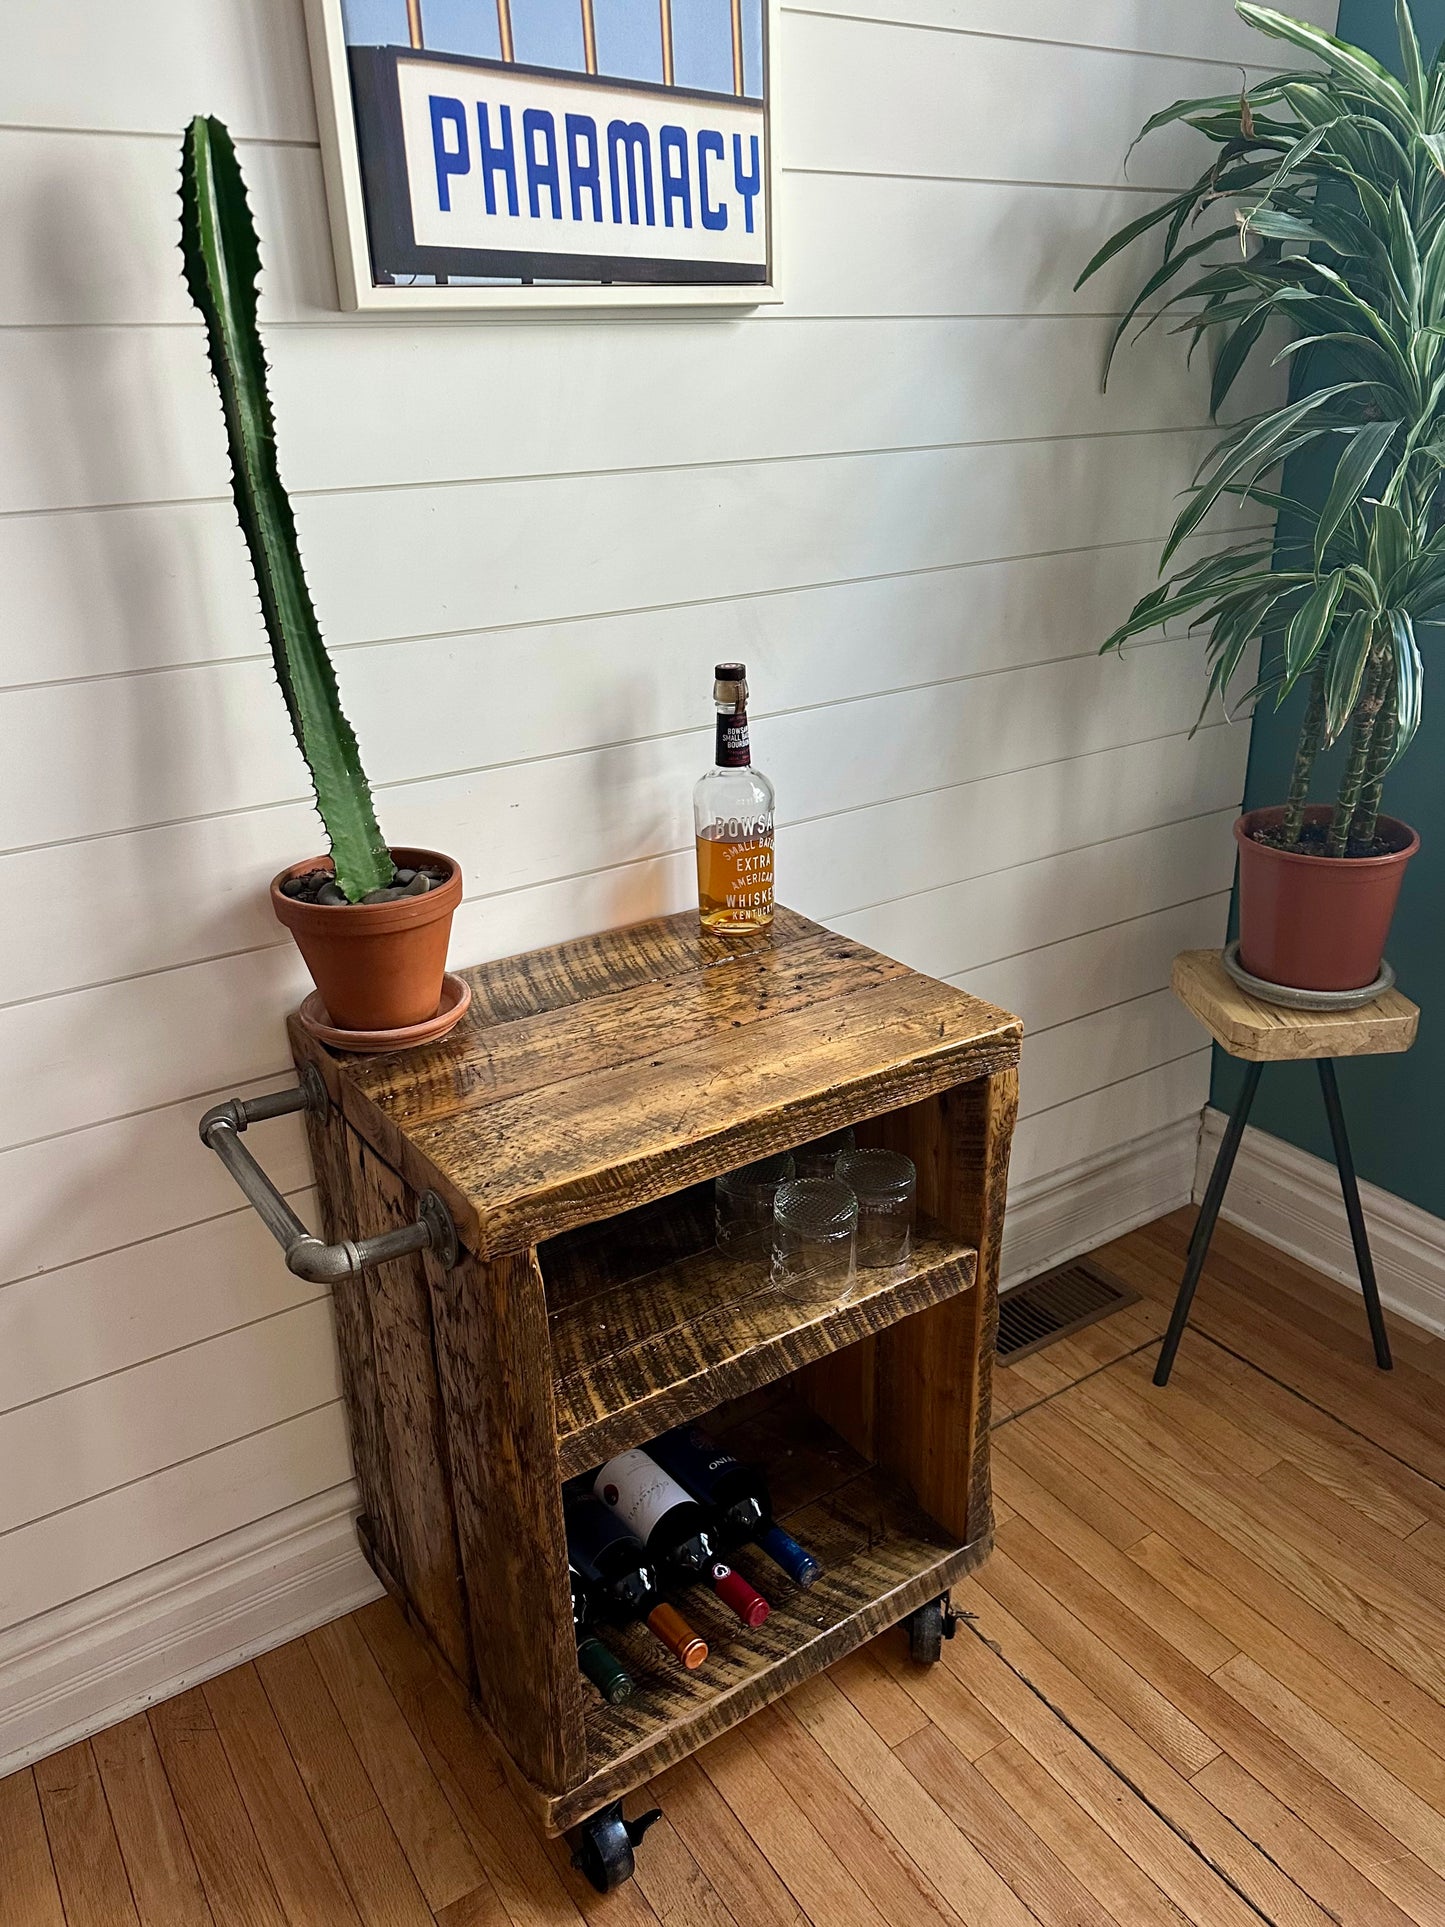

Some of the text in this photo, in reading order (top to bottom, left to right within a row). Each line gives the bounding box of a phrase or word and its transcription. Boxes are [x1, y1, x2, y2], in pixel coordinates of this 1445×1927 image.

[429, 95, 760, 233] PHARMACY
[715, 811, 773, 837] BOWSA
[722, 840, 756, 861] SMALL
[736, 853, 771, 872] EXTRA
